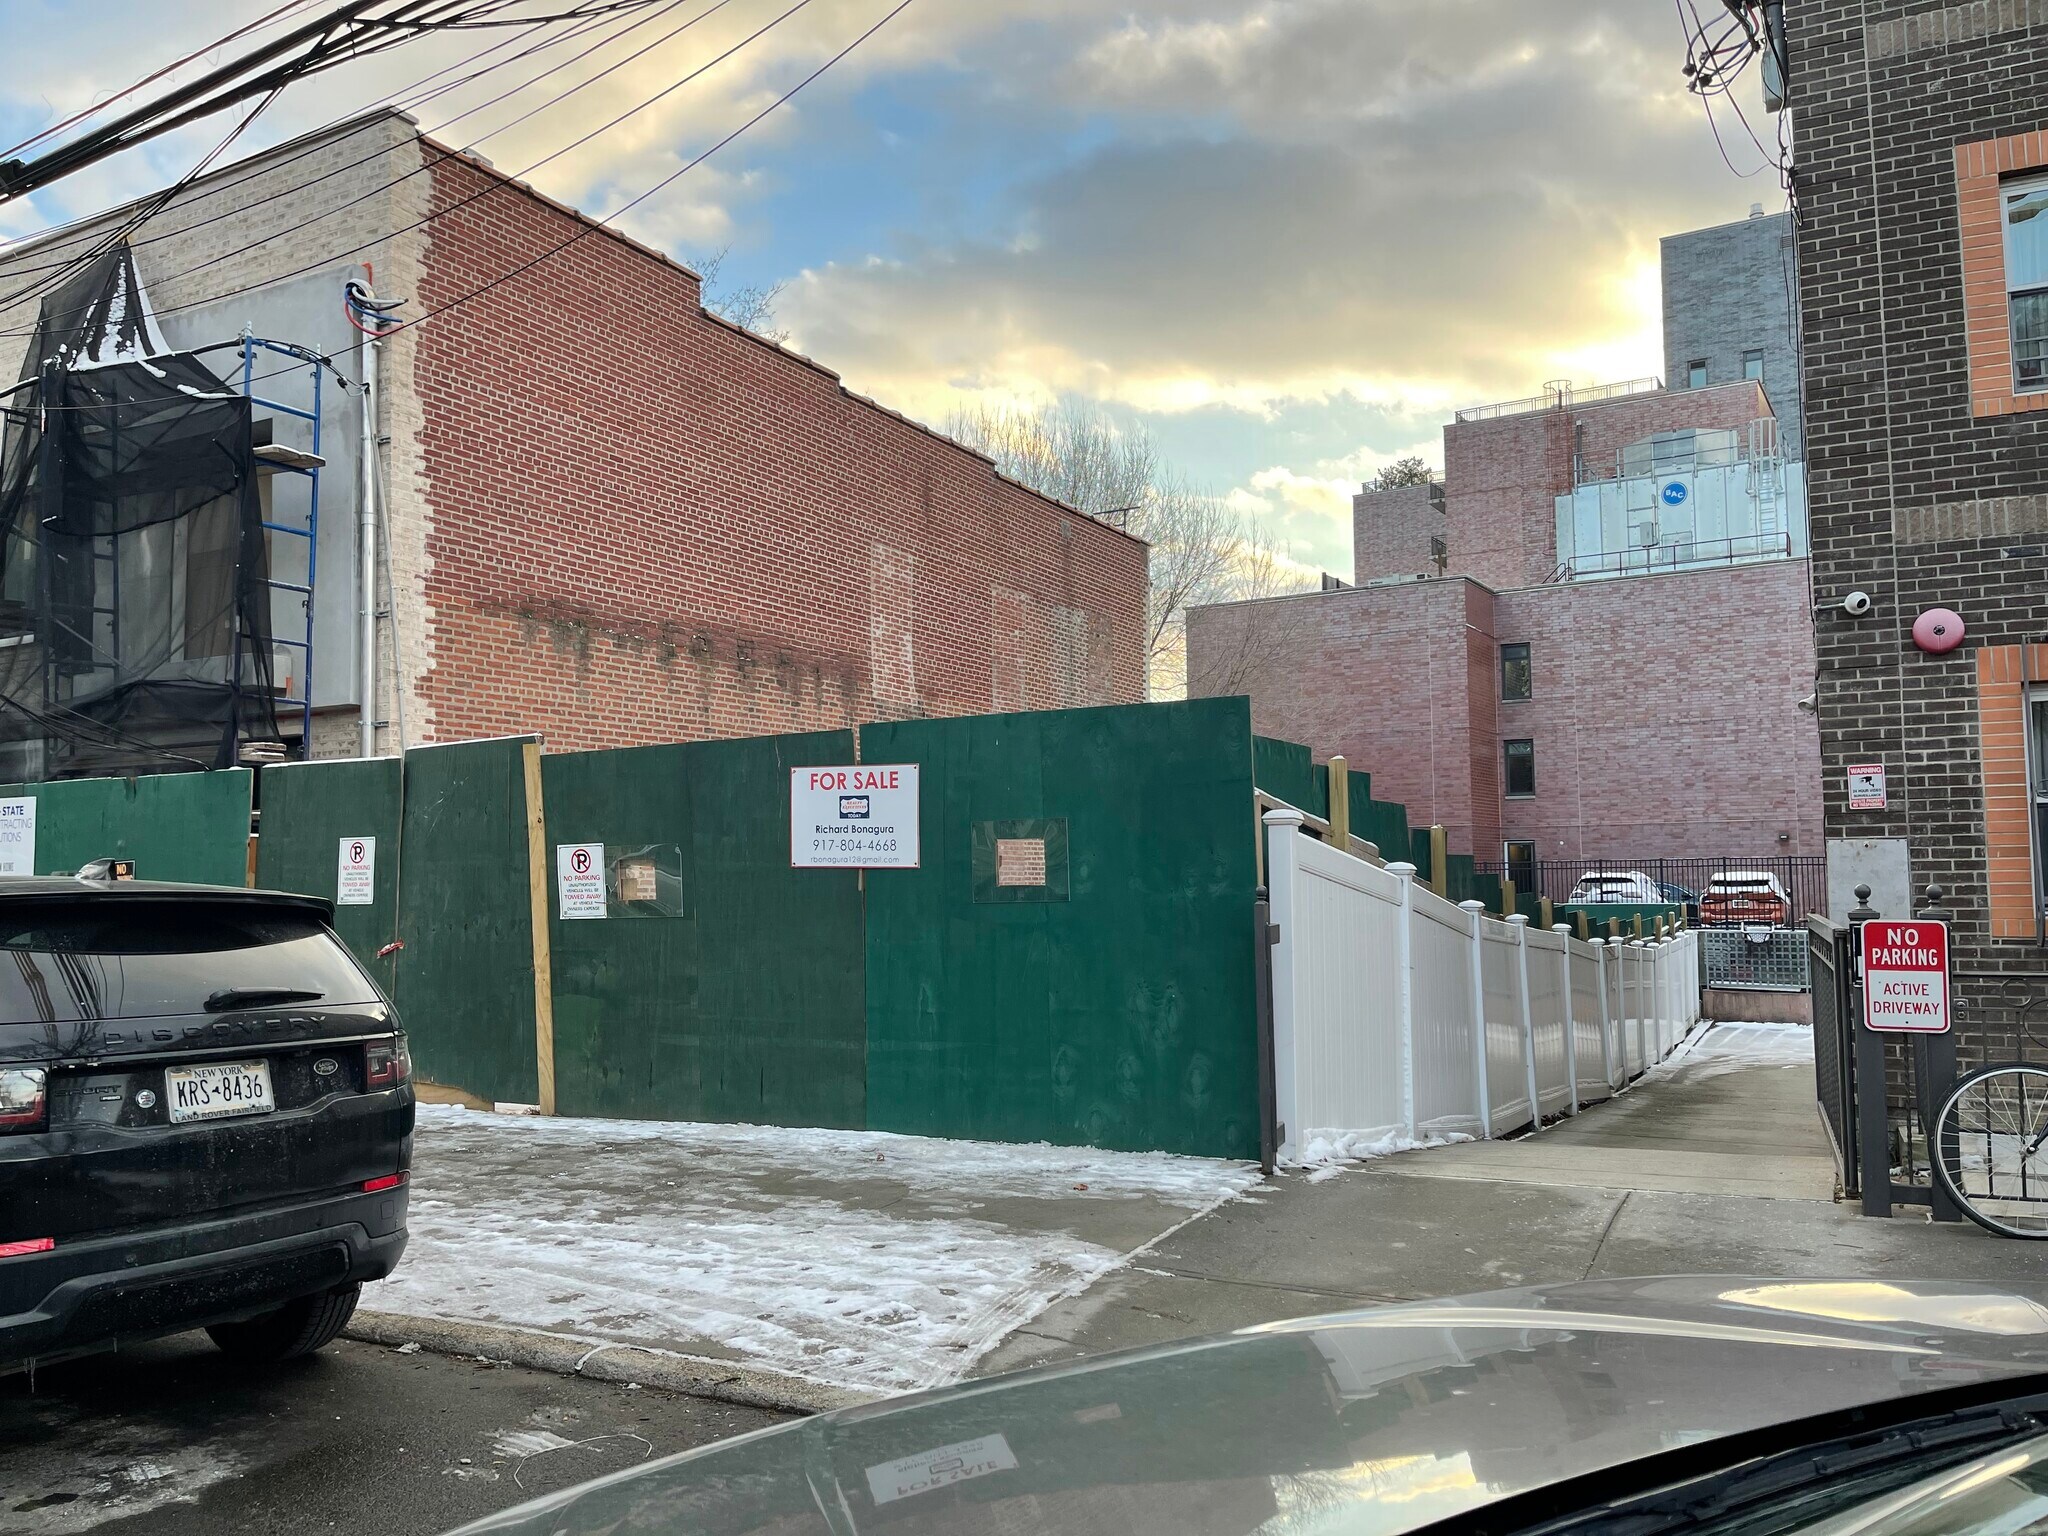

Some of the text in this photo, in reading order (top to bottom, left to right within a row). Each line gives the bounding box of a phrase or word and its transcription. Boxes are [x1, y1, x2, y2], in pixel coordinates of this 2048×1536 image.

[1665, 489, 1684, 499] BAC
[810, 770, 899, 791] FOR SALE
[815, 824, 894, 836] Richard Bonagura
[812, 838, 898, 852] 917-804-4668
[810, 855, 900, 865] rbonagura12@gmail.com
[116, 863, 127, 875] NO
[1887, 928, 1919, 946] NO
[1872, 948, 1938, 966] PARKING
[1883, 982, 1930, 997] ACTIVE
[1873, 1000, 1940, 1015] DRIVEWAY
[103, 1014, 326, 1046] DISCOVERY
[194, 1066, 243, 1079] NEW YORK
[176, 1079, 210, 1108] KRS
[222, 1074, 263, 1102] 8436
[175, 1104, 272, 1122] LAND ROVER FAIRFIELD
